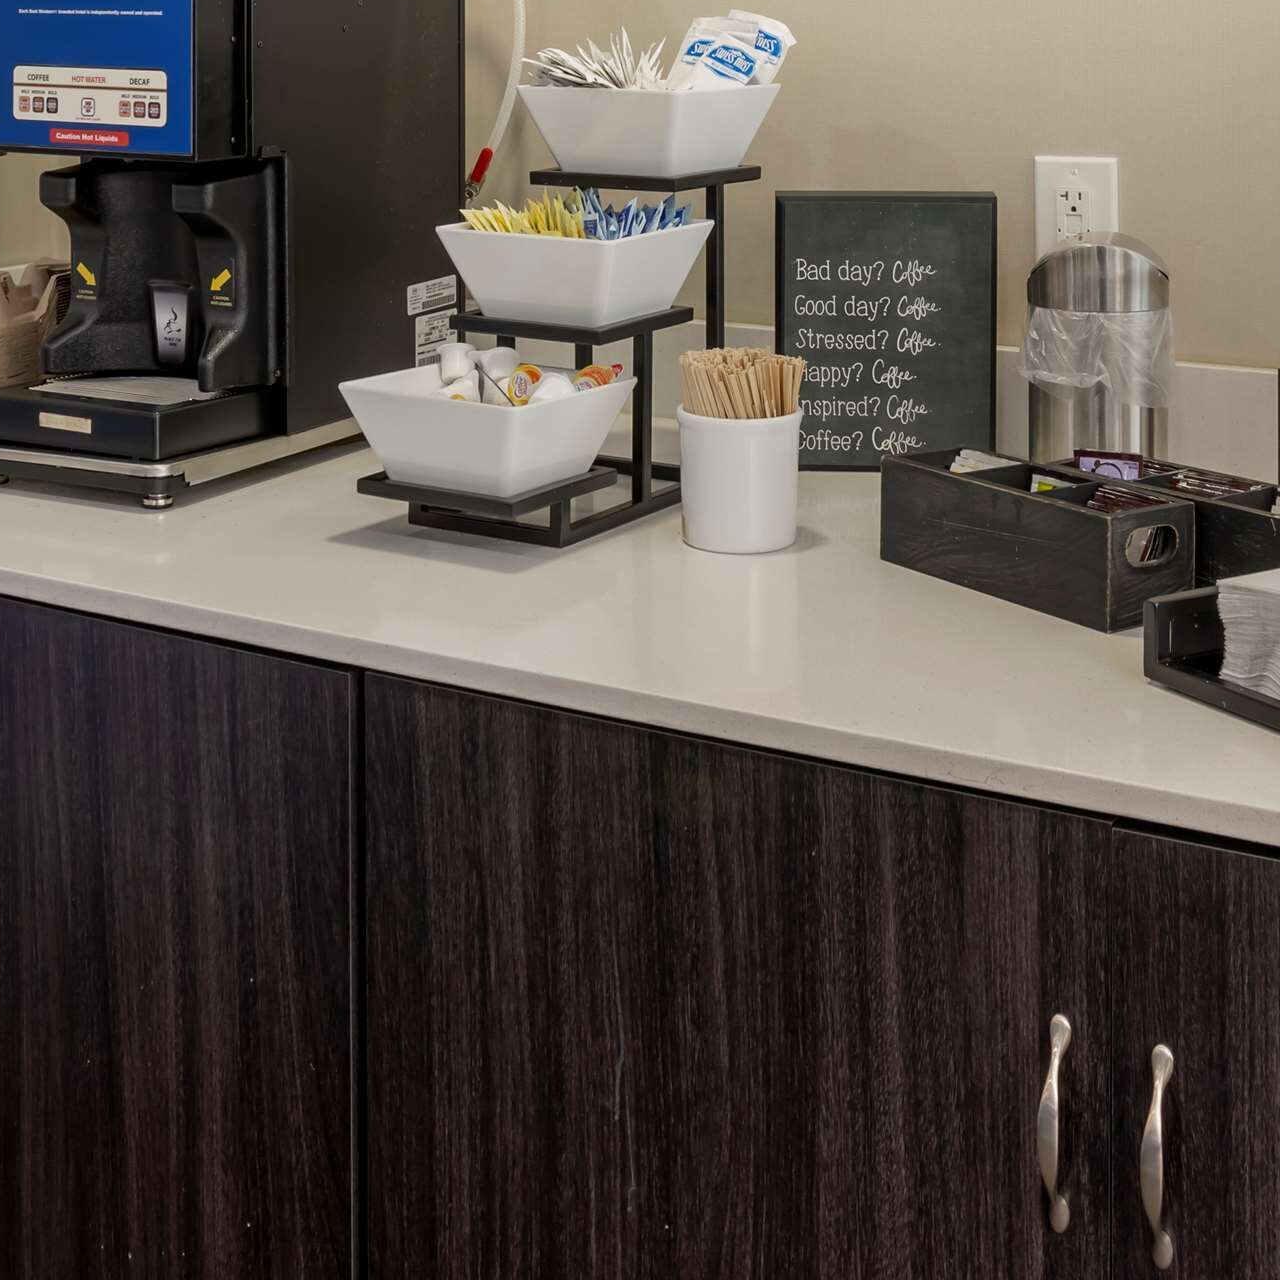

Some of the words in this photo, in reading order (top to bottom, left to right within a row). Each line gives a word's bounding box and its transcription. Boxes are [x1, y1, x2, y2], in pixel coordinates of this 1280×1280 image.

[27, 73, 49, 81] COFFEE
[71, 75, 85, 83] HOT
[85, 76, 106, 84] WATER
[129, 78, 150, 86] DECAF
[56, 132, 80, 140] Caution
[82, 133, 94, 141] Hot
[796, 258, 831, 281] Bad
[838, 260, 885, 286] day?
[794, 295, 837, 316] Good
[844, 296, 891, 321] day?
[795, 329, 889, 350] Stressed?
[801, 396, 880, 421] nspired?
